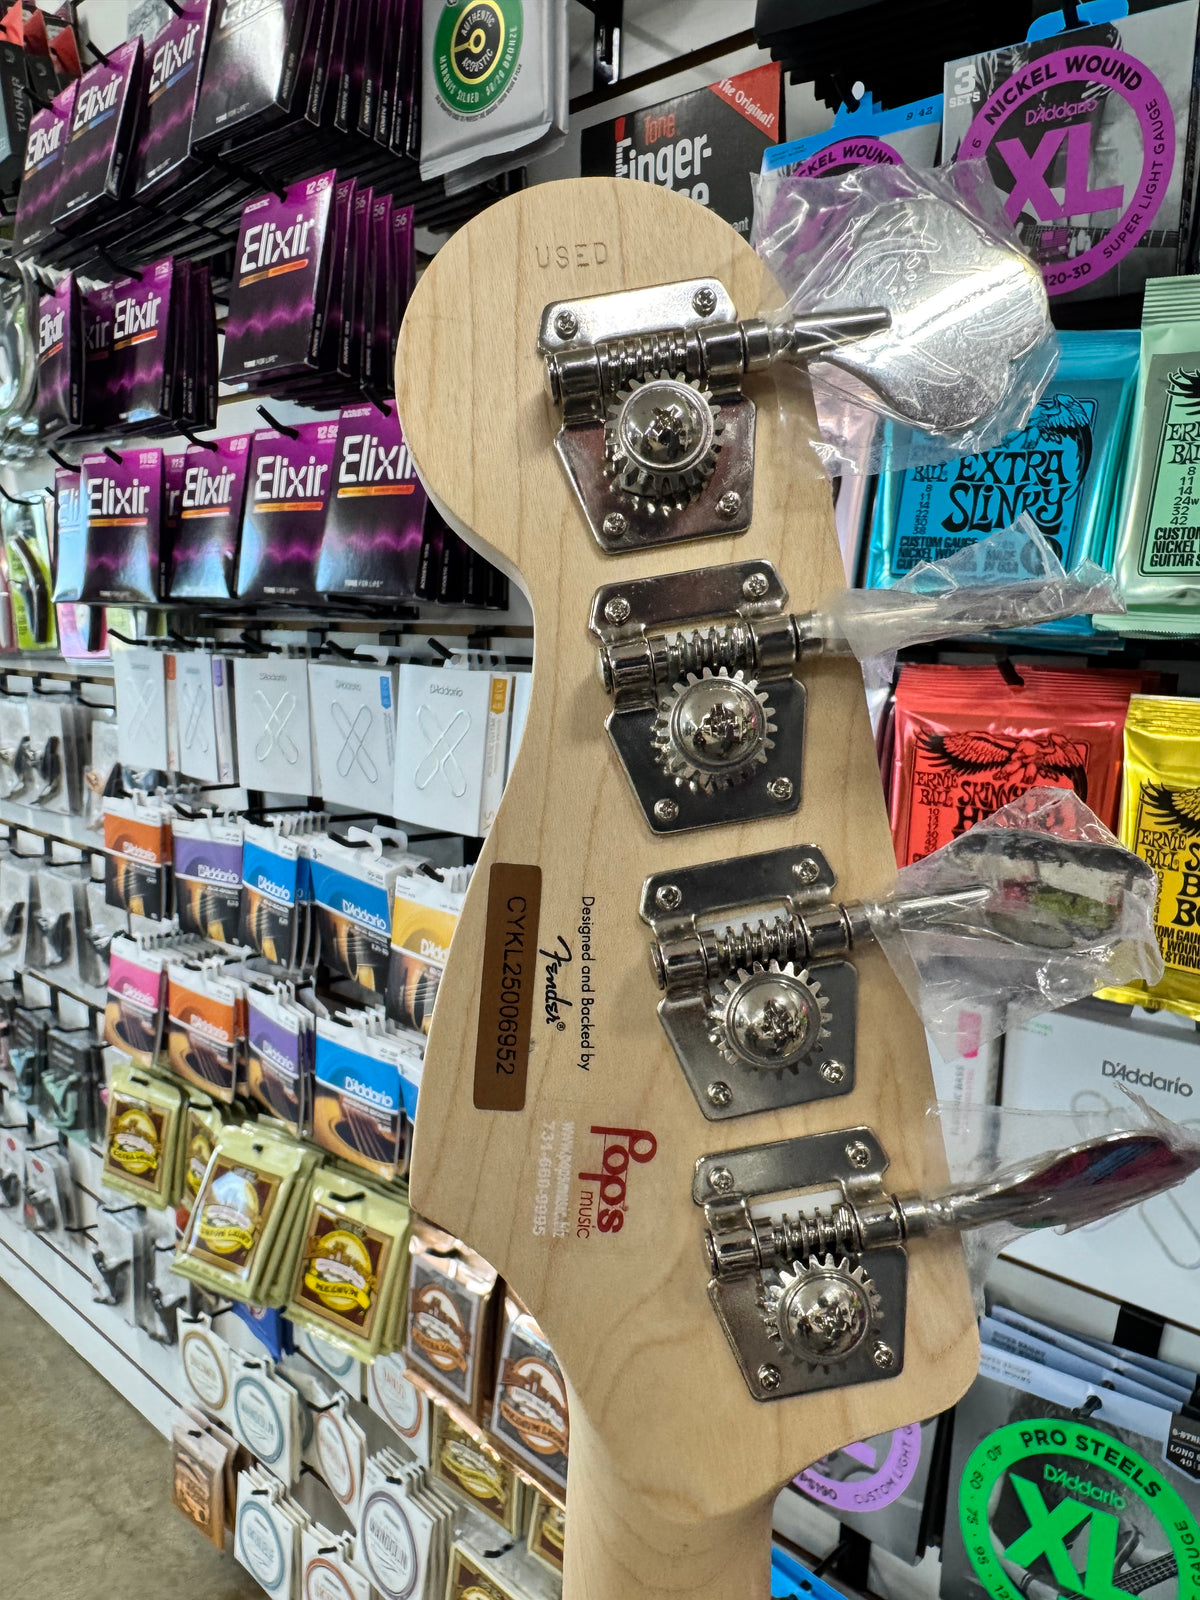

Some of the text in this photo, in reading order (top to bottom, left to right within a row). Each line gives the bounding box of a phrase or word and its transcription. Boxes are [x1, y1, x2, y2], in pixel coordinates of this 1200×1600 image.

[461, 10, 496, 36] AUTHENTIC
[148, 23, 200, 94] Elixir
[462, 48, 494, 72] ACOUSTIC
[954, 64, 977, 95] 3
[984, 54, 1143, 126] NICKEL WOUND
[73, 73, 123, 131] Elixir
[718, 78, 775, 128] The Original!
[906, 106, 934, 121] 9 42
[949, 91, 981, 108] SETS
[25, 118, 65, 171] Elixir
[644, 113, 677, 146] Tone
[797, 152, 837, 176] KEL
[843, 144, 894, 165] WOUND
[995, 122, 1125, 222] XL
[1103, 98, 1165, 259] SUPER LIGHT GAUGE
[239, 214, 316, 274] Elixir
[535, 242, 608, 269] USED
[113, 292, 162, 340] Elixir
[254, 455, 328, 500] Elixir
[911, 463, 948, 482] BALL
[954, 449, 1072, 487] EXTRA
[1180, 476, 1194, 486] 11
[1187, 466, 1196, 476] 8
[87, 478, 151, 517] Elixir
[182, 466, 236, 507] Elixir
[1178, 487, 1193, 496] 14
[58, 487, 80, 527] Eli
[941, 482, 1072, 535] SLINKY
[1170, 516, 1188, 526] 42
[1172, 506, 1190, 516] 32
[901, 536, 943, 547] CUSTOM
[1152, 540, 1196, 554] NICKEL
[1150, 554, 1193, 567] GUITAR
[915, 769, 958, 788] ERNIE
[958, 780, 1028, 807] SKINNY
[918, 788, 953, 807] BALL
[929, 808, 940, 816] 10
[1139, 828, 1188, 851] ERNIE
[1144, 849, 1180, 871] BALL
[342, 898, 387, 931] D'Addario
[1167, 938, 1200, 955] WOUN
[496, 896, 527, 1075] CYKL25006952
[539, 935, 573, 1026] Fender
[577, 896, 596, 1071] Designed and Backed by
[345, 1076, 393, 1107] D'Addario
[1102, 1059, 1193, 1097] D'Addario
[579, 1126, 657, 1233] Pops
[577, 1190, 597, 1239] music
[1019, 1429, 1162, 1498] PRO STEELS
[1170, 1444, 1195, 1459] LONG
[854, 1478, 896, 1504] CUSTOM
[1043, 1463, 1128, 1510] D'Addario
[1004, 1472, 1148, 1600] XL
